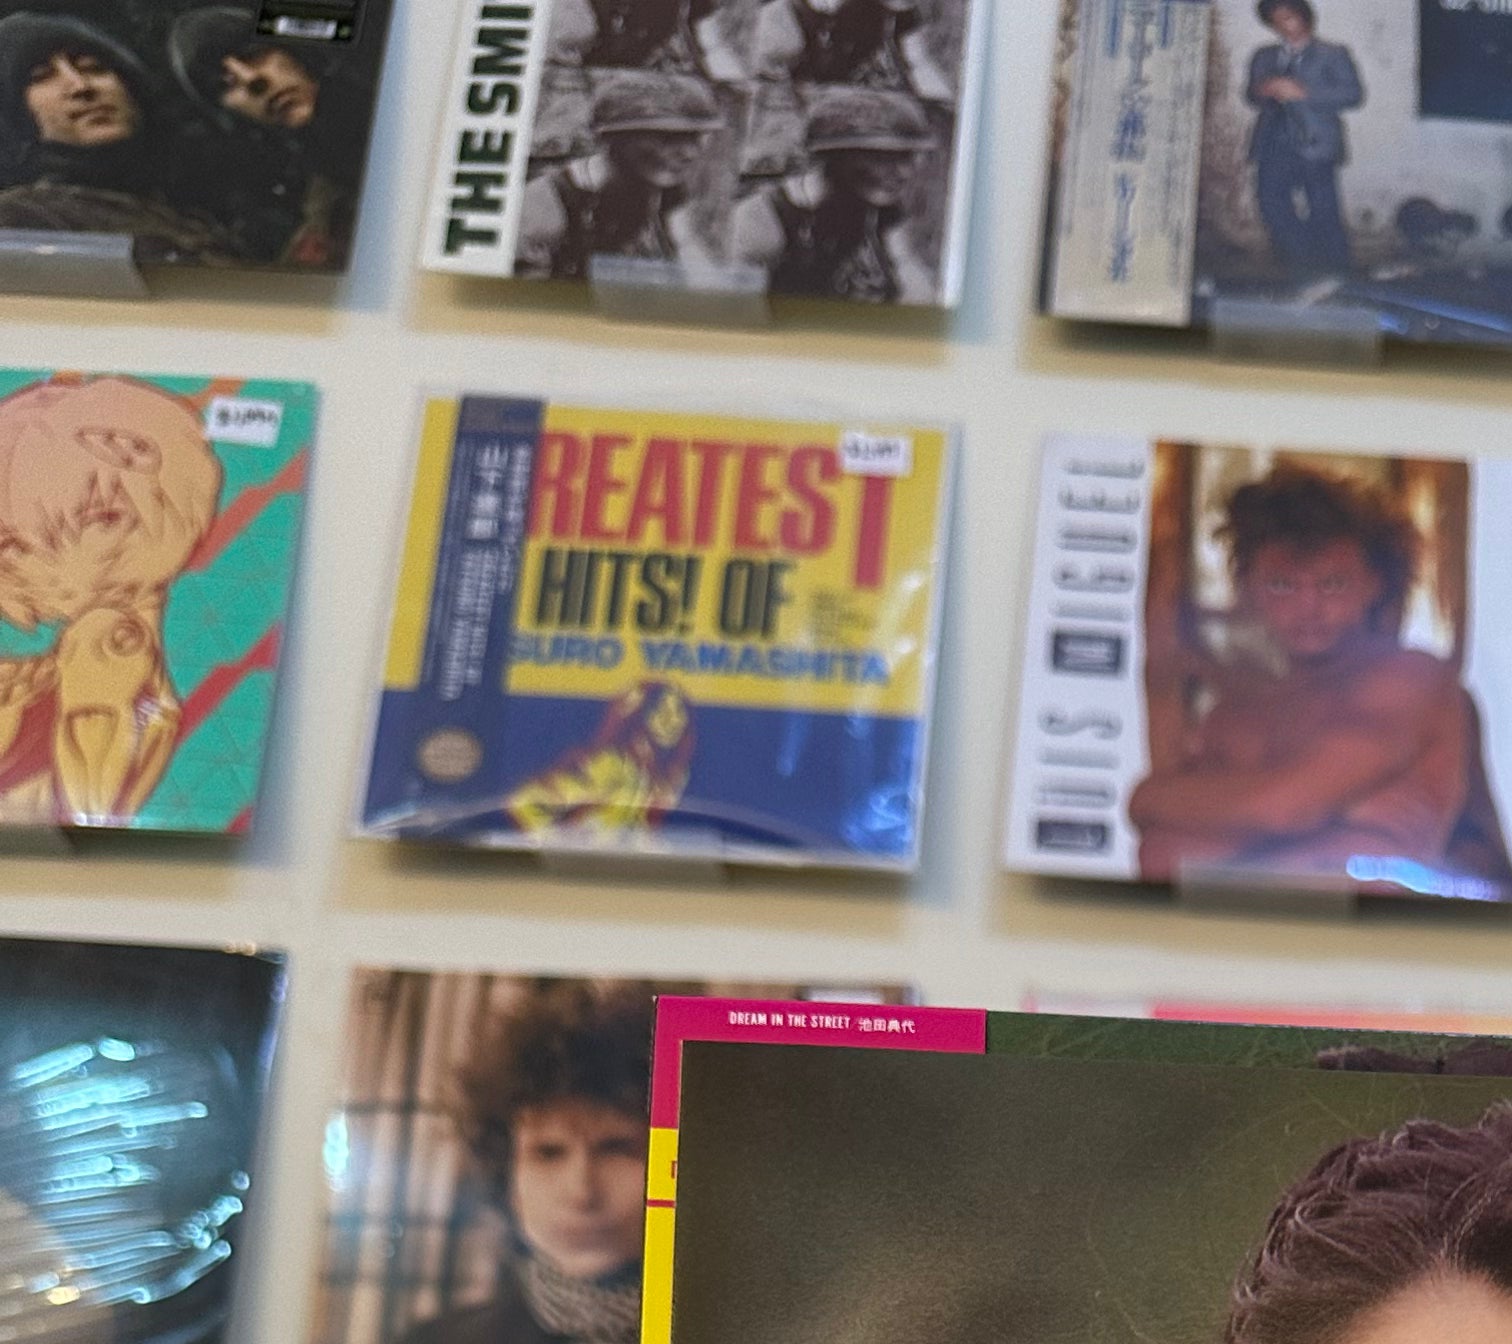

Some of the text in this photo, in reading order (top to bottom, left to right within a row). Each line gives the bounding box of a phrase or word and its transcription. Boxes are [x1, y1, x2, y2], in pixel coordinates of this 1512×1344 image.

[444, 130, 518, 257] THE
[533, 546, 694, 632] HITS!
[717, 558, 798, 640] OF
[640, 639, 891, 685] YAMASHITA
[1032, 459, 1146, 853] LUIS MIGUEL
[728, 1011, 916, 1034] DREAM IN THE STREET 池田典代
